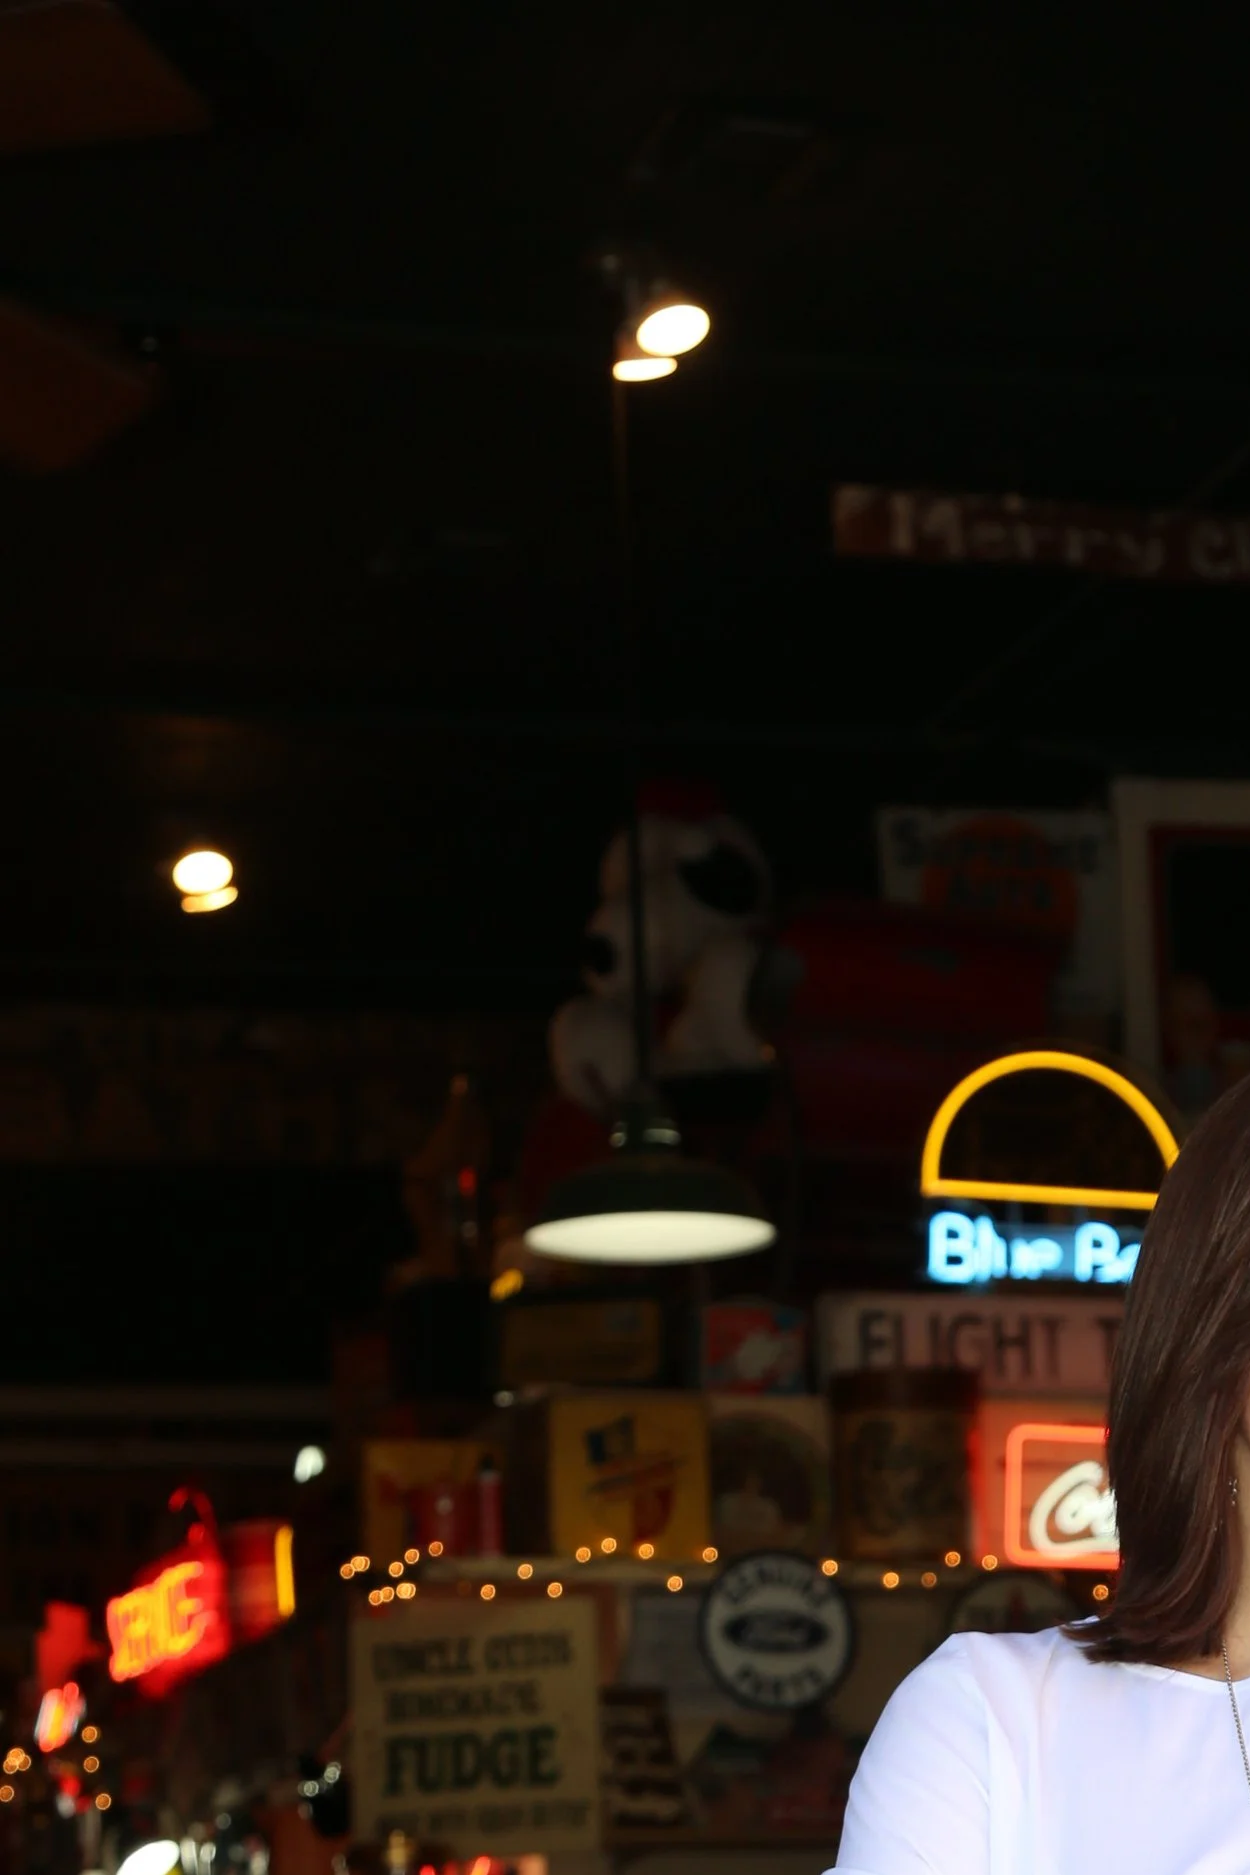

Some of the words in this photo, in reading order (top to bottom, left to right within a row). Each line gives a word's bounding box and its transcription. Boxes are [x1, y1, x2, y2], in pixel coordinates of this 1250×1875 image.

[890, 490, 1165, 576] Merry
[927, 1210, 1063, 1284] Blue
[383, 1725, 563, 1798] FUDGE
